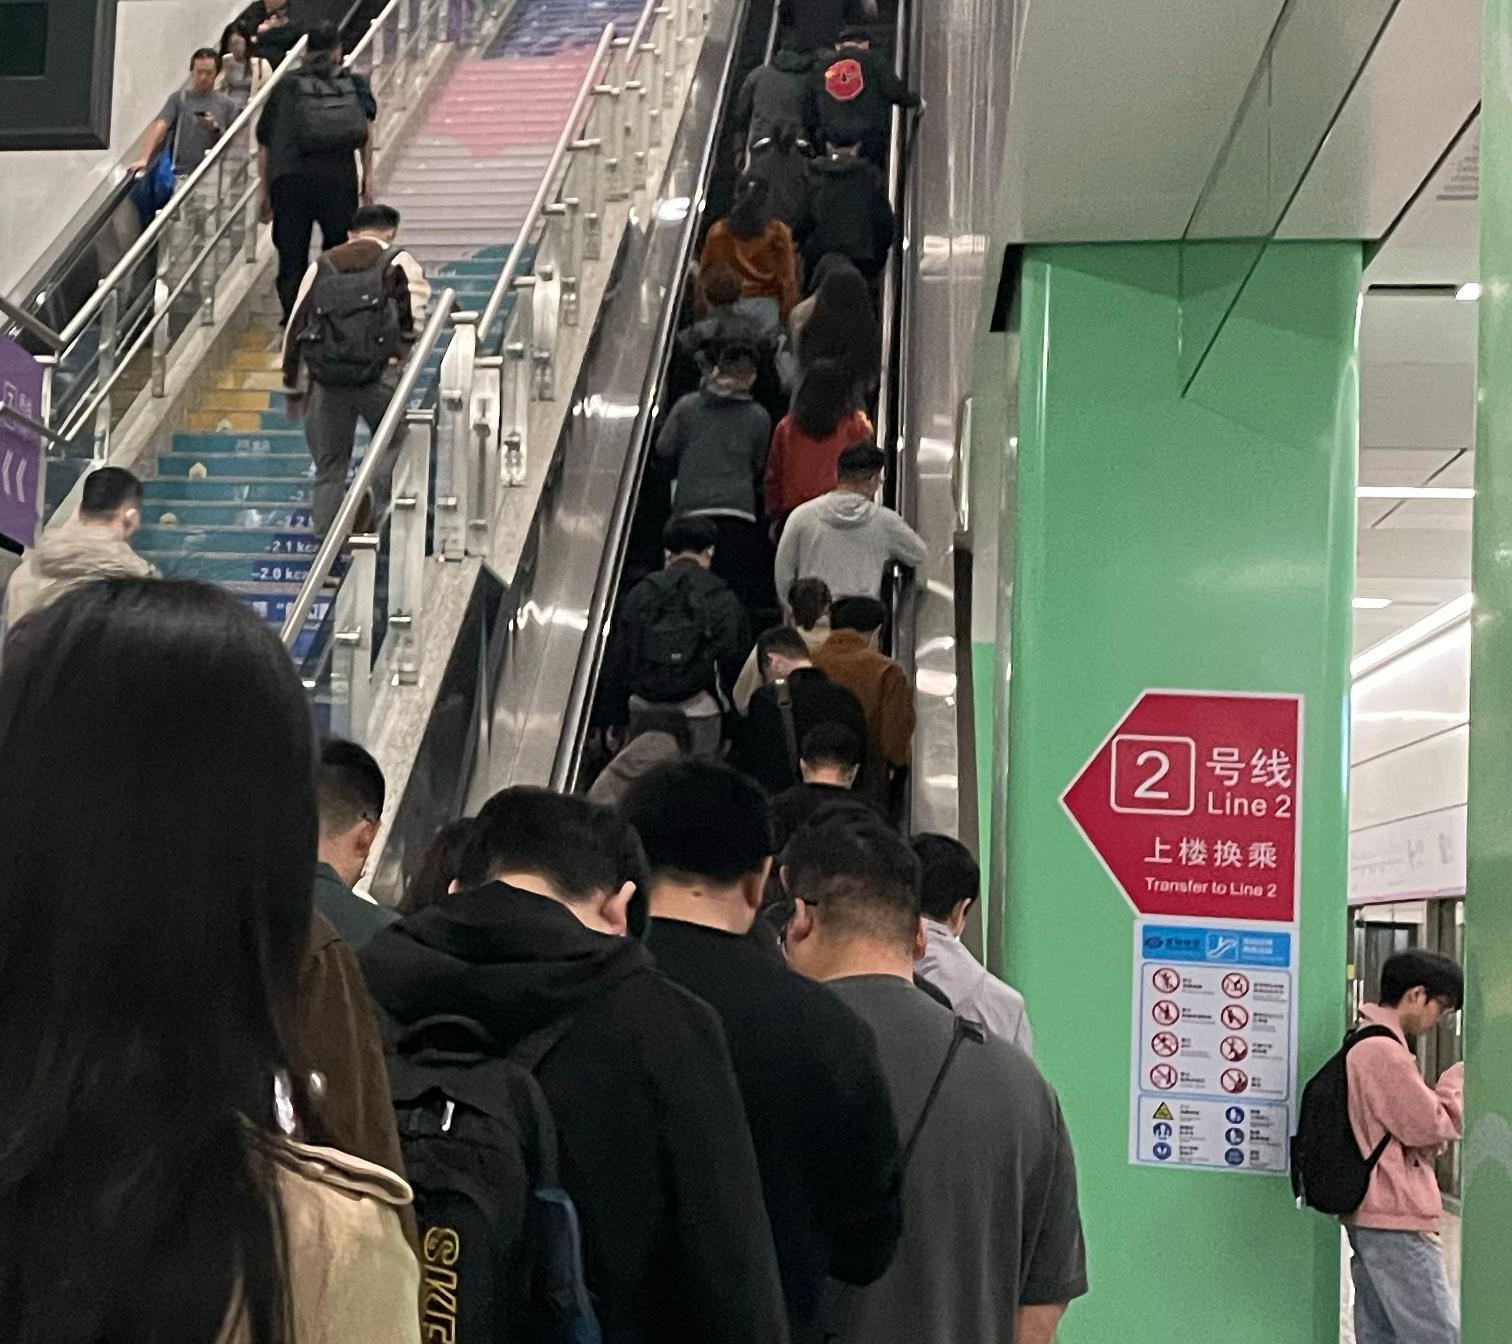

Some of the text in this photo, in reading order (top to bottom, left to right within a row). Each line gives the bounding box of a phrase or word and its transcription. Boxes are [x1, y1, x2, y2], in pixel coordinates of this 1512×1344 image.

[1133, 747, 1292, 799] 2 号线
[1208, 791, 1292, 818] Line 2
[1144, 836, 1277, 869] 上楼换乘
[1144, 877, 1277, 898] Transfer to Line 2
